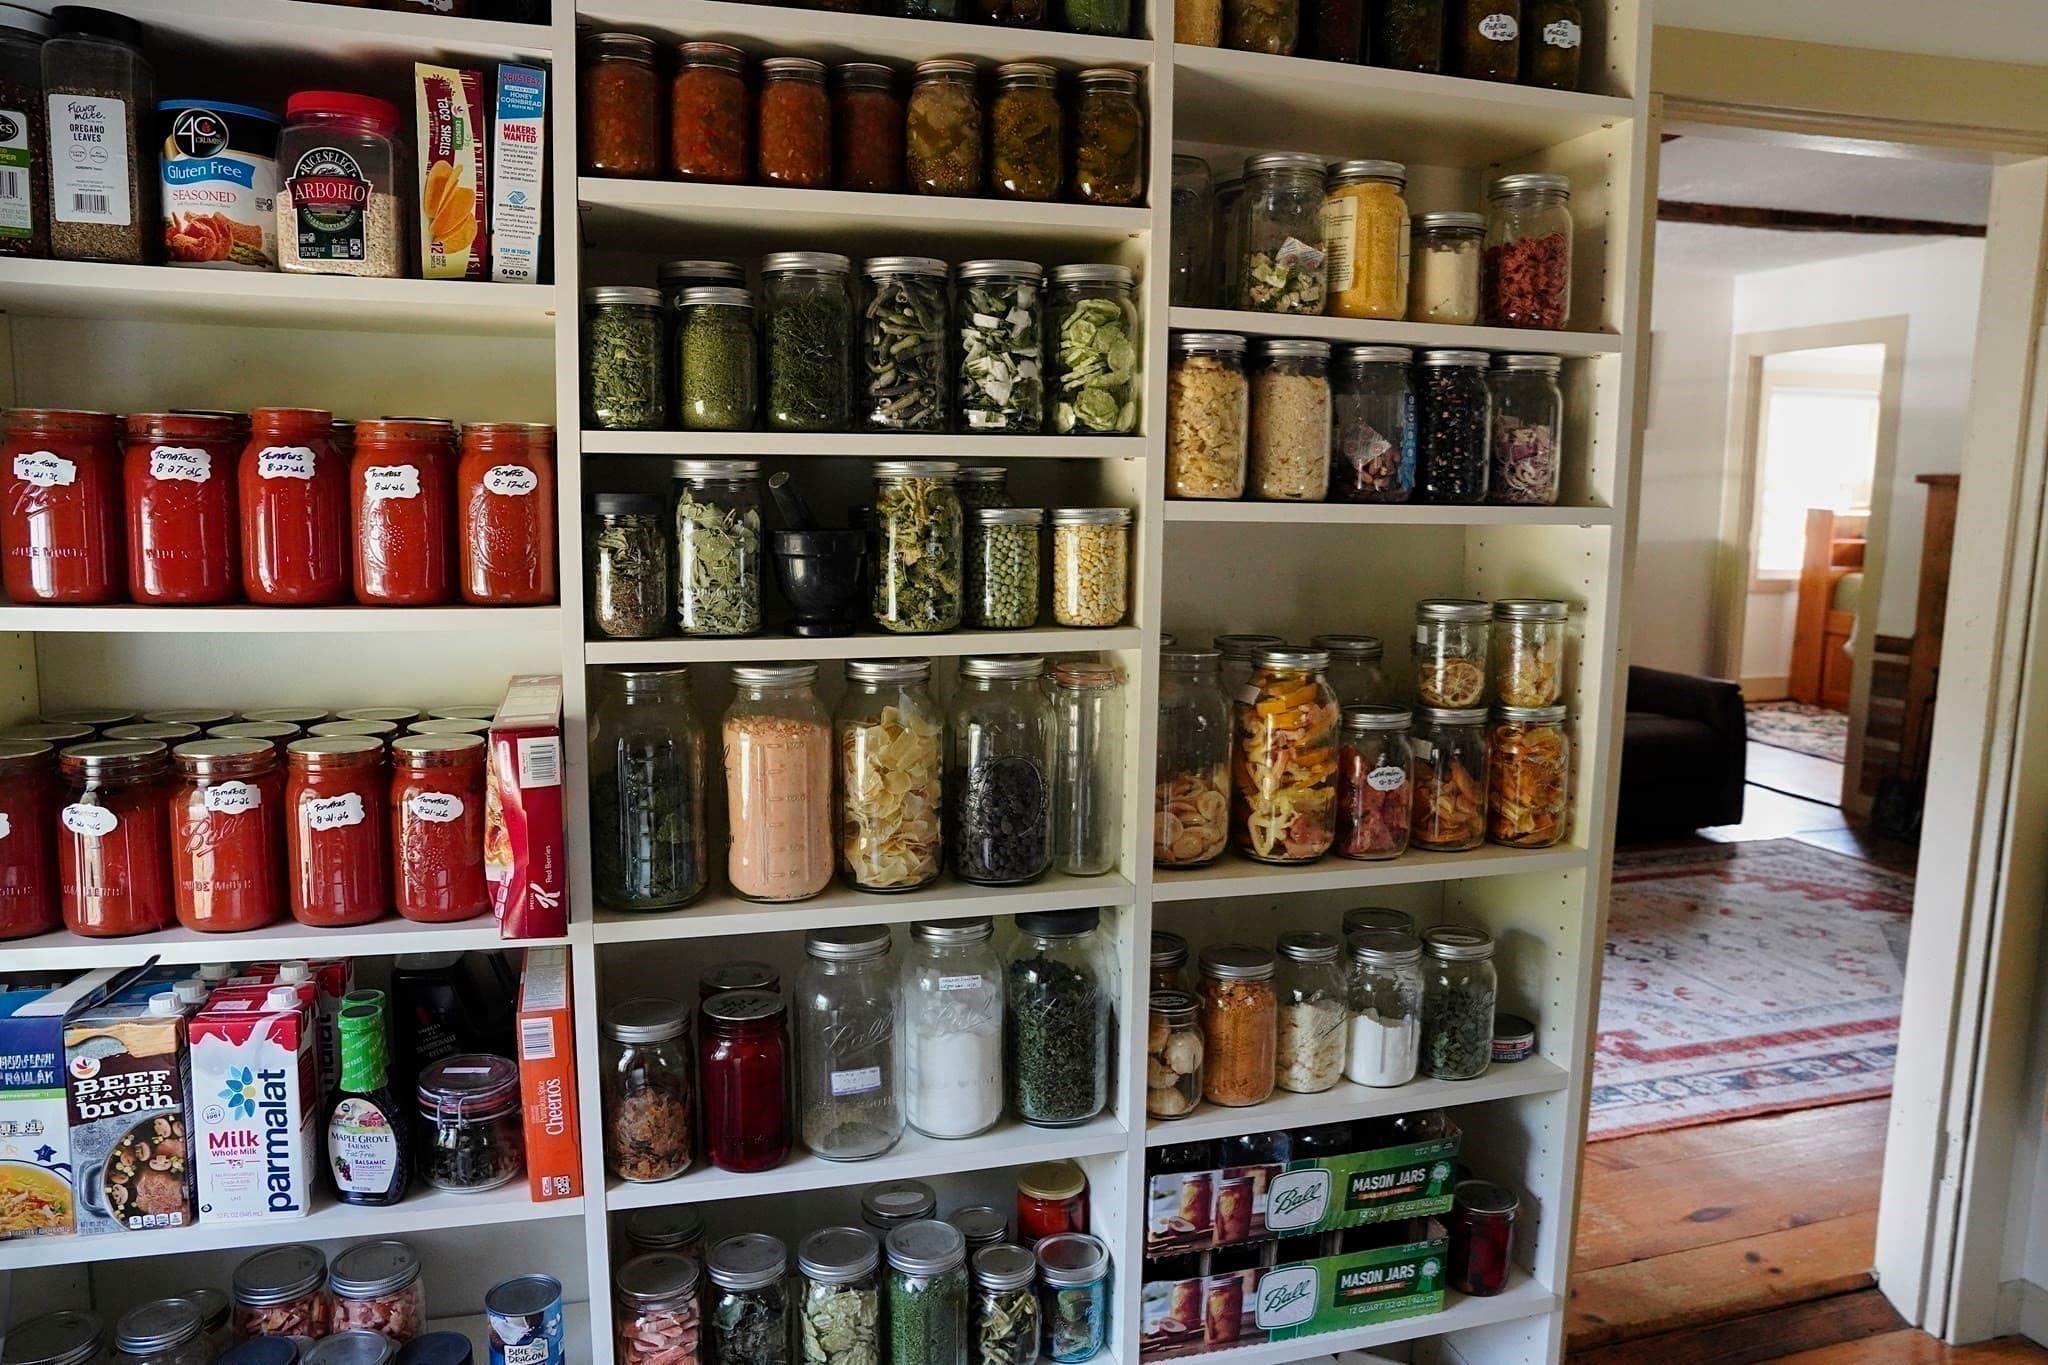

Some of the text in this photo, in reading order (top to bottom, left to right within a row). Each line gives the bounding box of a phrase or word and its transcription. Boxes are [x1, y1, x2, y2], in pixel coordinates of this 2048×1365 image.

[500, 96, 543, 108] CORNBREAD
[510, 91, 534, 101] HONEY
[67, 101, 97, 114] Flavor
[69, 123, 105, 135] OREGANO
[73, 132, 102, 143] LEAVES
[177, 115, 217, 153] 4C
[503, 123, 537, 136] MAKERS
[503, 131, 537, 144] WANTED
[167, 161, 242, 180] Gluten Free
[300, 150, 357, 174] RICESELECT
[172, 190, 237, 203] SEASONED
[294, 182, 366, 202] ARBORIO
[431, 241, 444, 254] 12
[544, 844, 553, 883] Red Berries
[529, 882, 561, 909] K
[73, 1070, 171, 1096] BEEF
[75, 1084, 173, 1104] FLAVORED
[75, 1092, 177, 1120] broth
[545, 1078, 565, 1136] Cheerios
[209, 1130, 260, 1150] Milk
[258, 1068, 299, 1213] parmalat
[331, 1132, 391, 1144] MAPLE GROVE
[212, 1148, 257, 1158] Whole Milk
[345, 1149, 358, 1158] Fat
[1352, 1173, 1397, 1193] MASON
[1396, 1168, 1427, 1186] JARS
[1274, 1182, 1322, 1215] Ball
[1340, 1263, 1416, 1289] MASON JARS
[1264, 1279, 1312, 1313] Ball
[506, 1351, 545, 1364] DRAGON
[508, 1347, 529, 1356] BLUE
